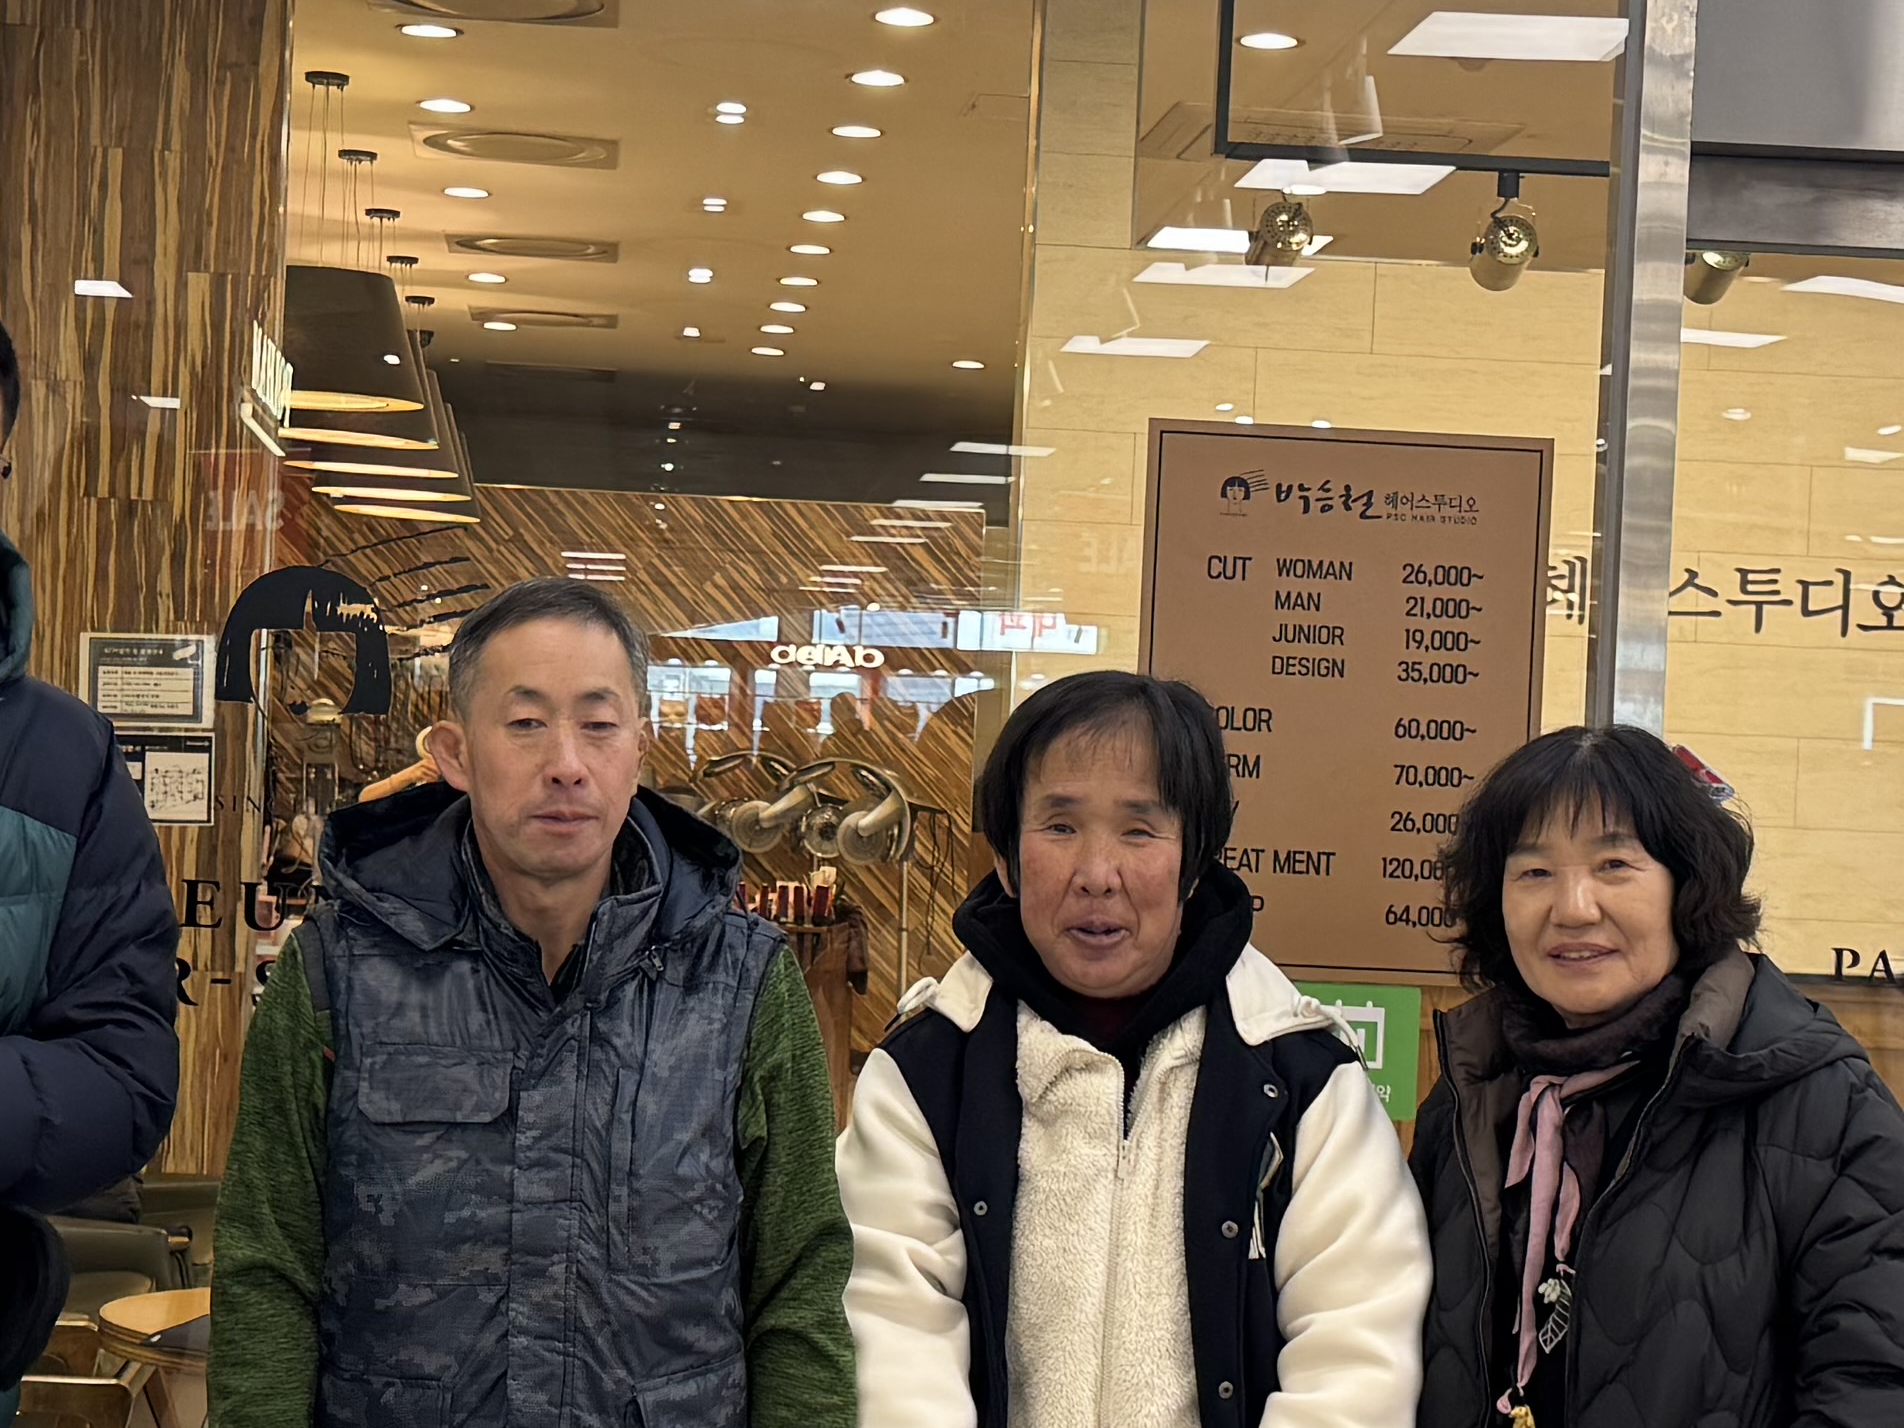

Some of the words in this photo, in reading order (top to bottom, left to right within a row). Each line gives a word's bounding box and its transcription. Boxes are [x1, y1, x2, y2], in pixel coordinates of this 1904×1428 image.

[1275, 479, 1384, 520] 박승철
[1384, 491, 1480, 514] 헤어스투디오
[1412, 514, 1437, 523] HAIR
[1440, 515, 1479, 526] STUDIO
[1207, 555, 1253, 582] CUT
[1276, 557, 1354, 582] WOMAN
[1401, 563, 1485, 588] 26,000~
[1274, 590, 1322, 613] MAN
[1405, 596, 1484, 620] 21,000~
[1272, 623, 1346, 647] JUNIOR
[1404, 628, 1482, 653] 19,000~
[1271, 655, 1346, 679] DESIGN
[1397, 661, 1481, 685] 35,000~
[1214, 706, 1274, 733] OLOR
[1394, 717, 1478, 742] 60,000~
[1393, 763, 1476, 788] 70,000~
[1272, 849, 1337, 877] MENT
